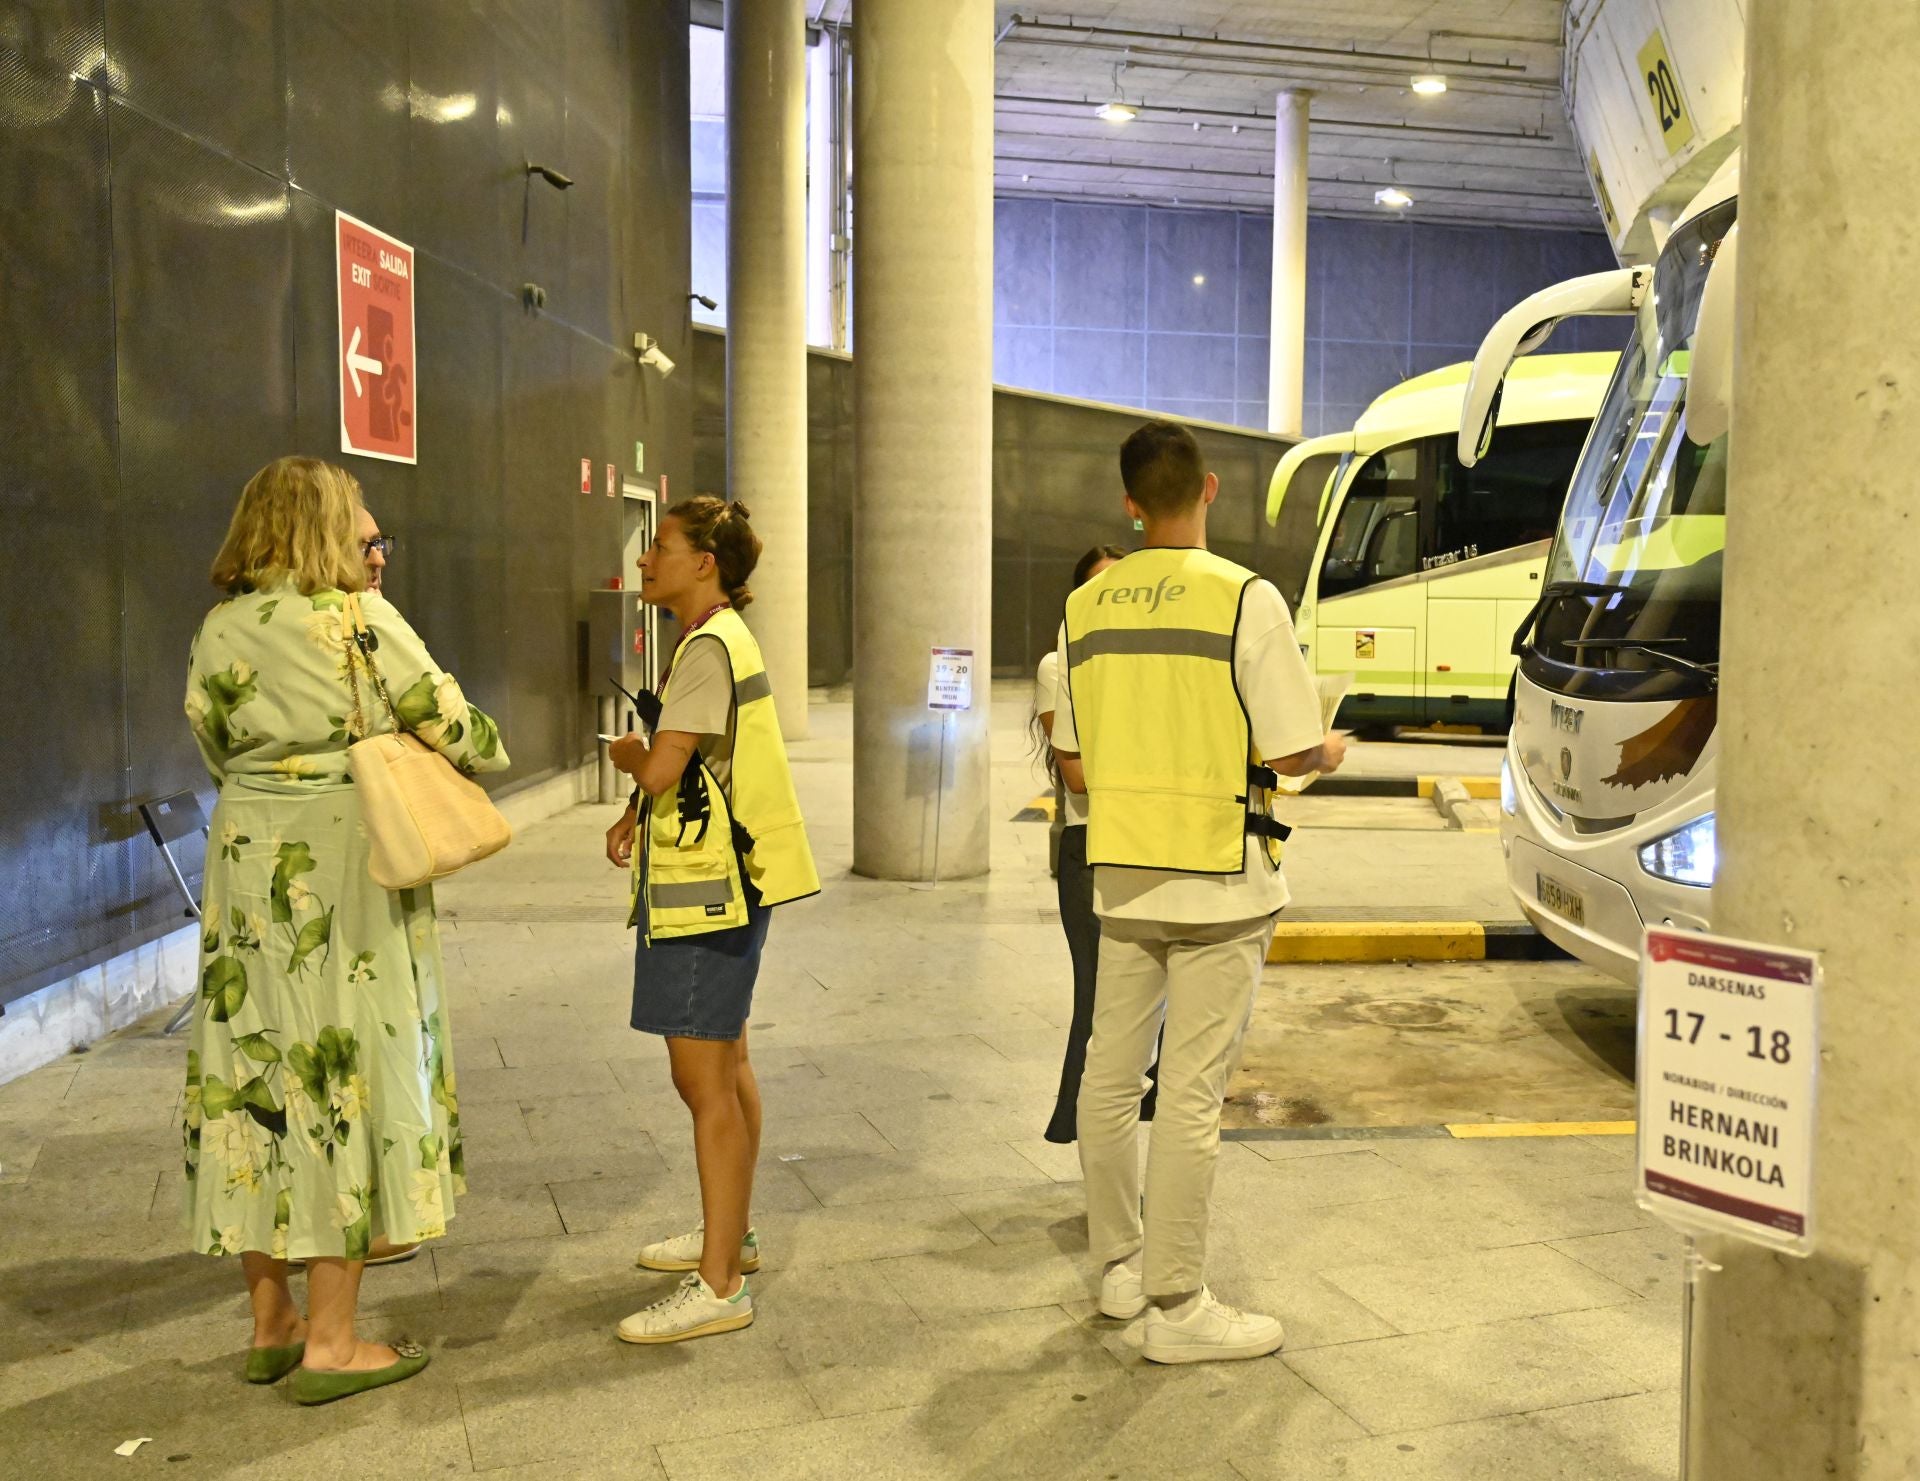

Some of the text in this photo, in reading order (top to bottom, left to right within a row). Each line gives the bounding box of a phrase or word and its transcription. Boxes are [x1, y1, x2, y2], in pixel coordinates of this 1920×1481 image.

[1647, 58, 1681, 133] 20
[351, 262, 372, 289] EXIT
[379, 249, 409, 280] SALIDA
[1096, 574, 1186, 614] renfe
[956, 665, 968, 674] 20
[1688, 972, 1766, 1000] DARSENAS
[1664, 1008, 1705, 1045] 17
[1747, 1025, 1792, 1066] 18
[1662, 1070, 1717, 1095] NORABIDE
[1727, 1085, 1789, 1110] DIRECCIÓN
[1669, 1100, 1779, 1149] HERNANI
[1663, 1134, 1785, 1189] BRINKOLA
